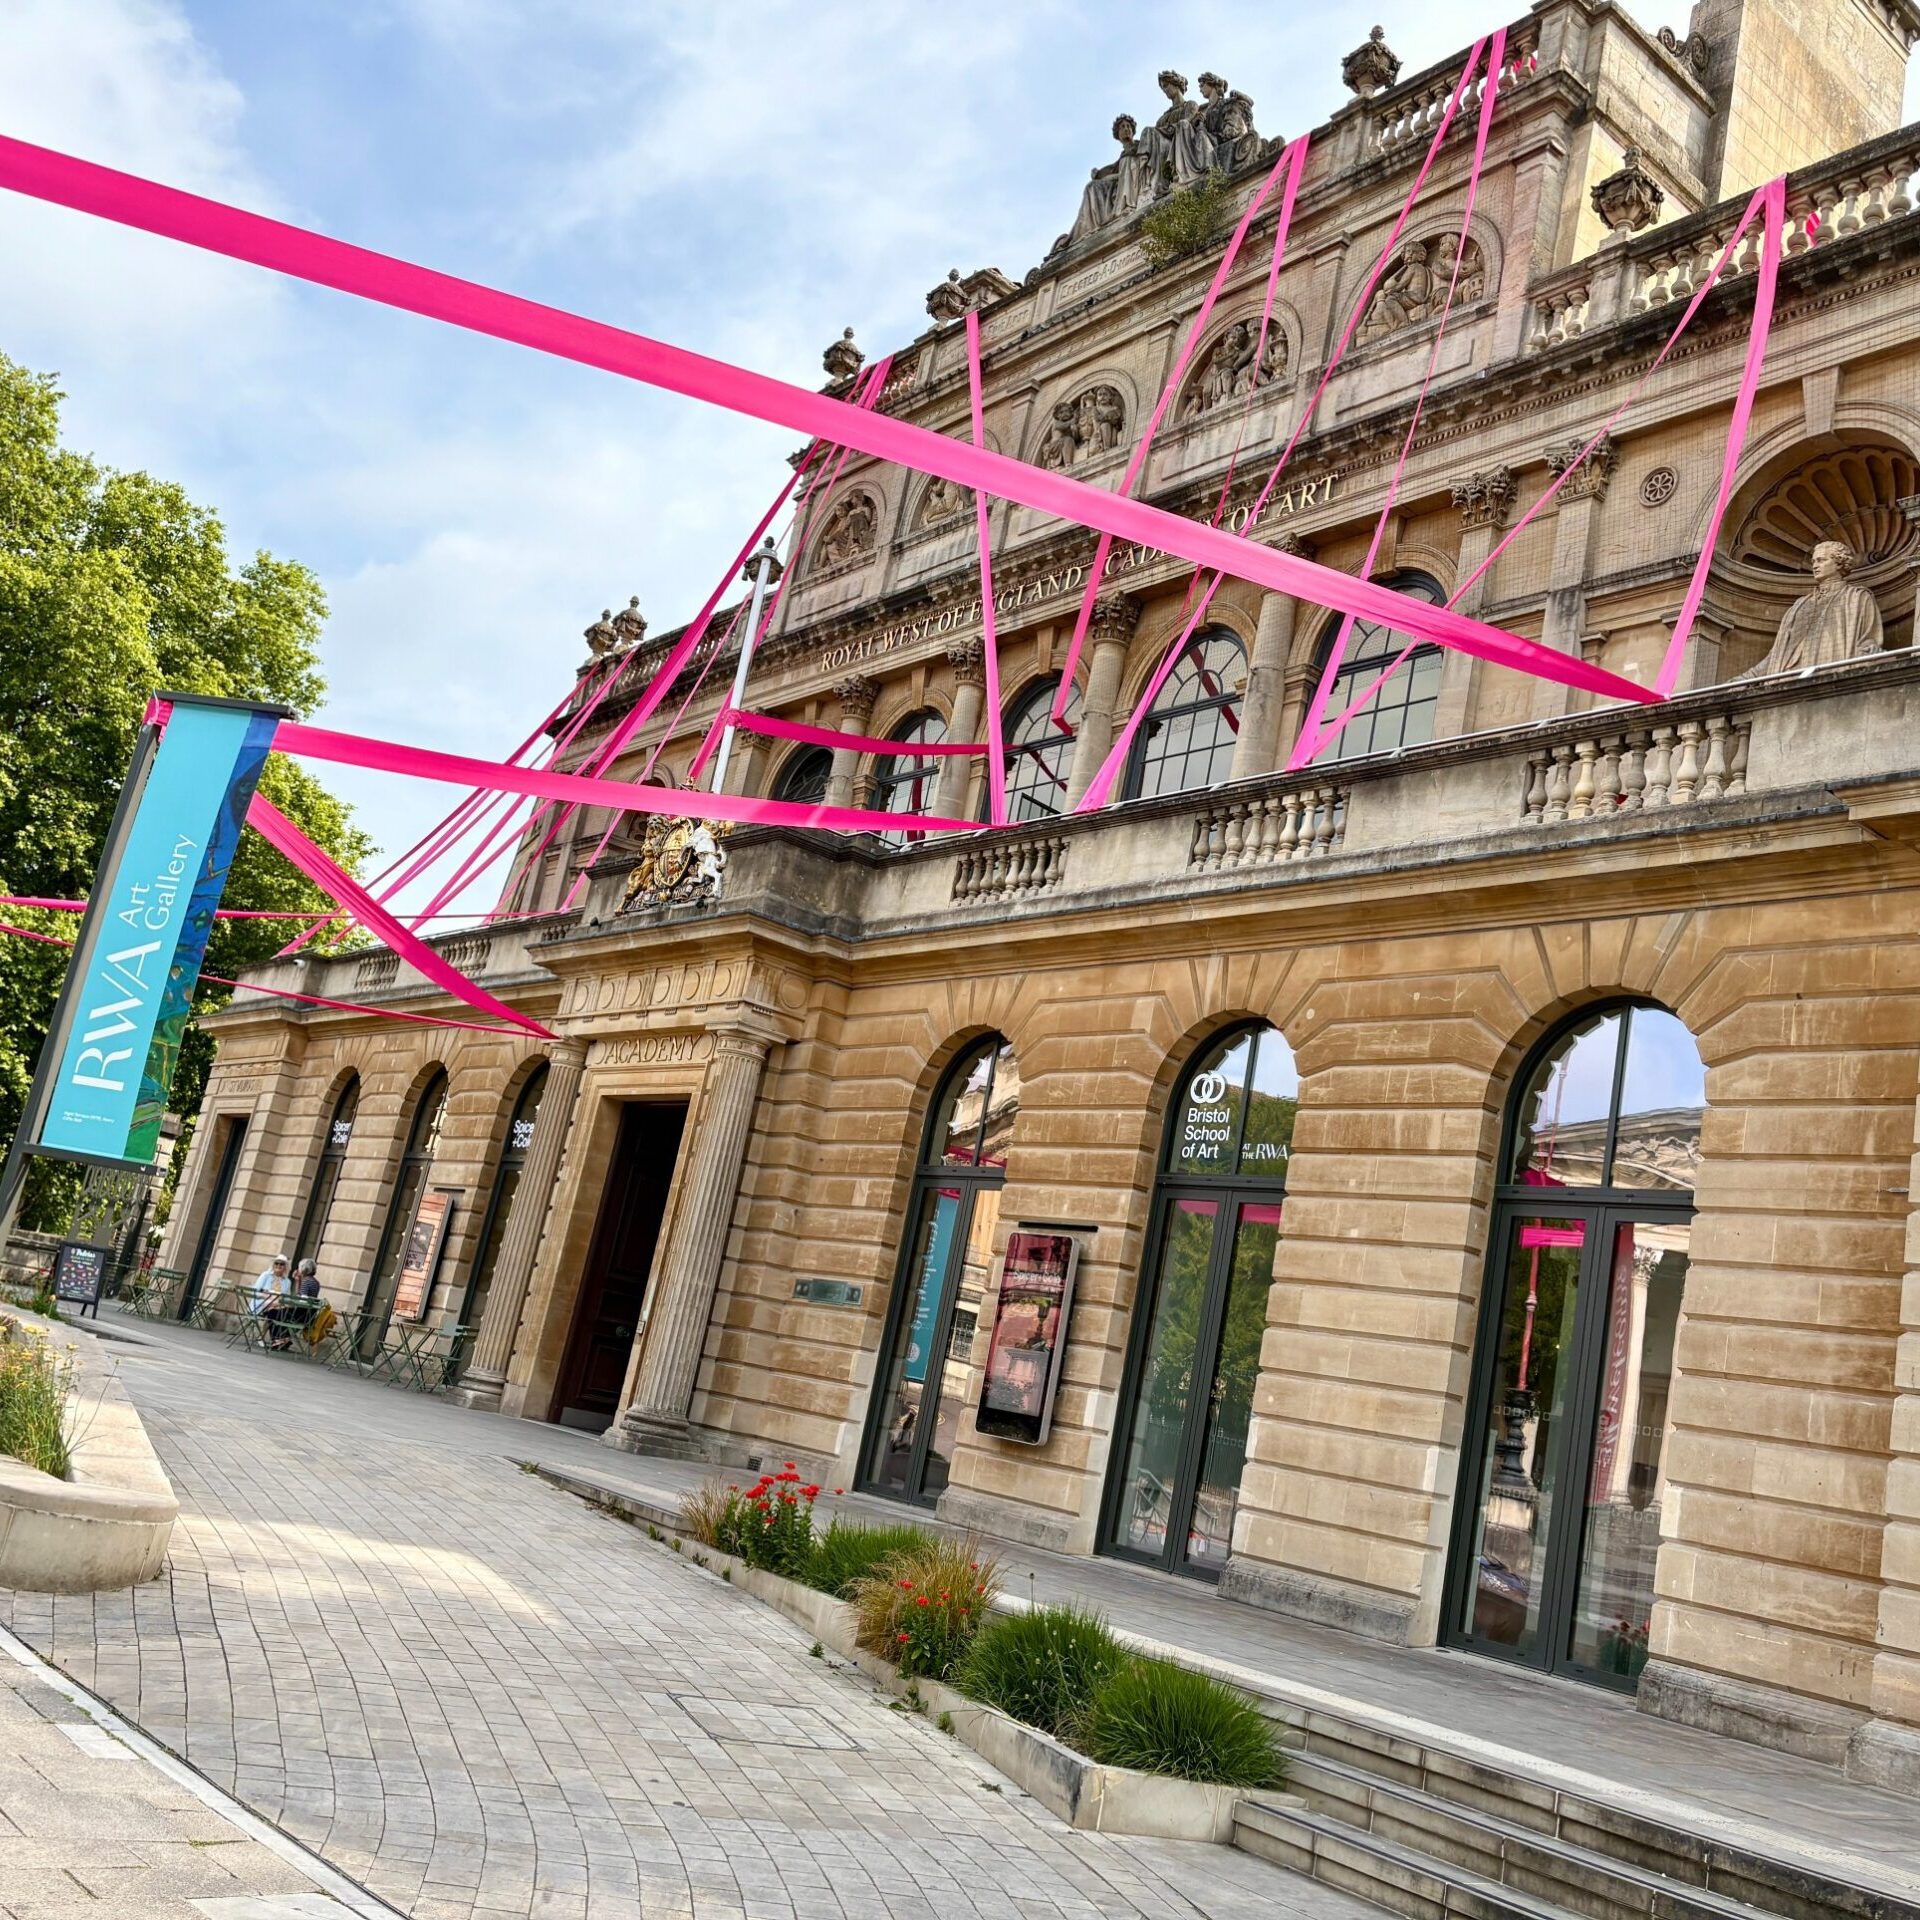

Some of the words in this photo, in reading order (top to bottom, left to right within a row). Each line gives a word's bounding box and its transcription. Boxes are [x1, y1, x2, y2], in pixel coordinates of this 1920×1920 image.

[821, 637, 876, 672] ROYAL
[882, 617, 934, 652] WEST
[938, 605, 965, 633] OF
[1230, 498, 1270, 531] OF
[1277, 473, 1339, 518] ART
[144, 834, 198, 930] Gallery
[119, 882, 150, 928] Art
[72, 940, 162, 1091] RWA
[605, 1033, 703, 1065] ACADEMY
[1187, 1107, 1231, 1123] Bristol
[513, 1120, 535, 1136] Spice
[1184, 1125, 1231, 1142] School
[512, 1133, 532, 1148] +Col
[1242, 1143, 1252, 1151] AT
[1181, 1143, 1196, 1159] of
[1196, 1143, 1220, 1159] Art
[1242, 1152, 1256, 1160] THE
[1255, 1143, 1288, 1160] RWA
